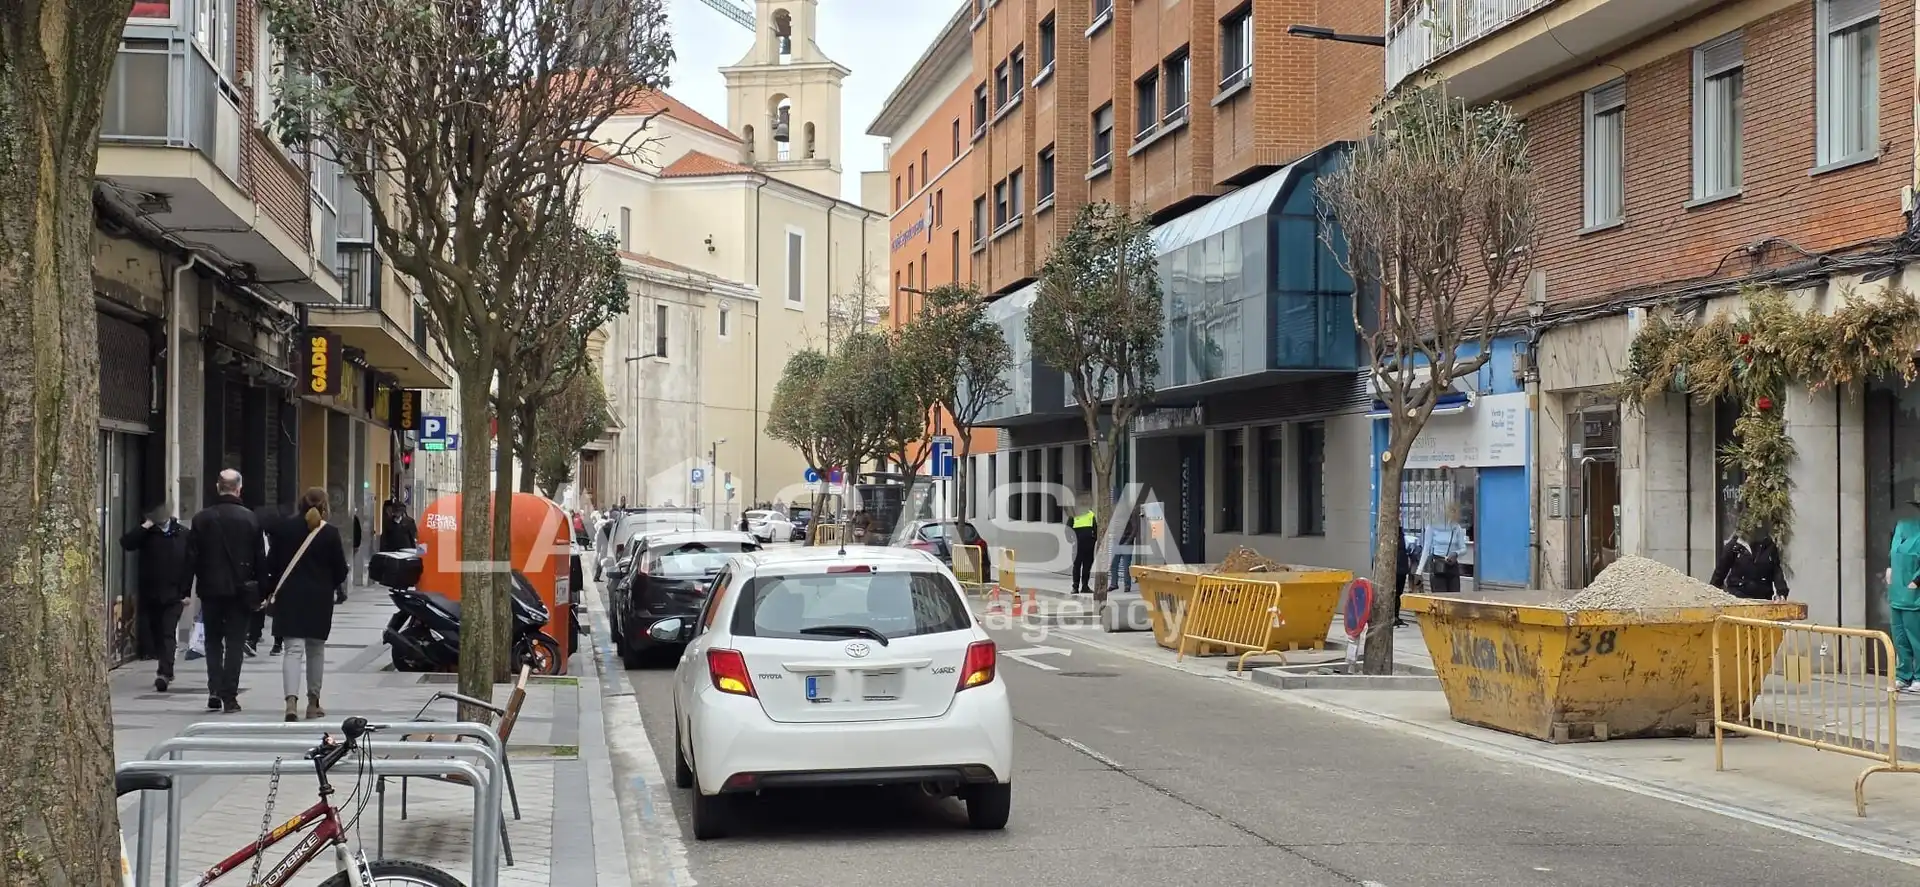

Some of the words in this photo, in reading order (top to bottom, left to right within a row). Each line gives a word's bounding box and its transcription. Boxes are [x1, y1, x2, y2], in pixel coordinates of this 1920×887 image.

[311, 336, 328, 393] GADIS
[402, 392, 412, 428] GADIS
[425, 419, 440, 437] P
[693, 470, 701, 482] P
[1182, 457, 1190, 544] HOSPITAL
[1571, 630, 1618, 657] 38
[931, 667, 956, 676] YARIS
[262, 834, 318, 887] TOPBIKE
